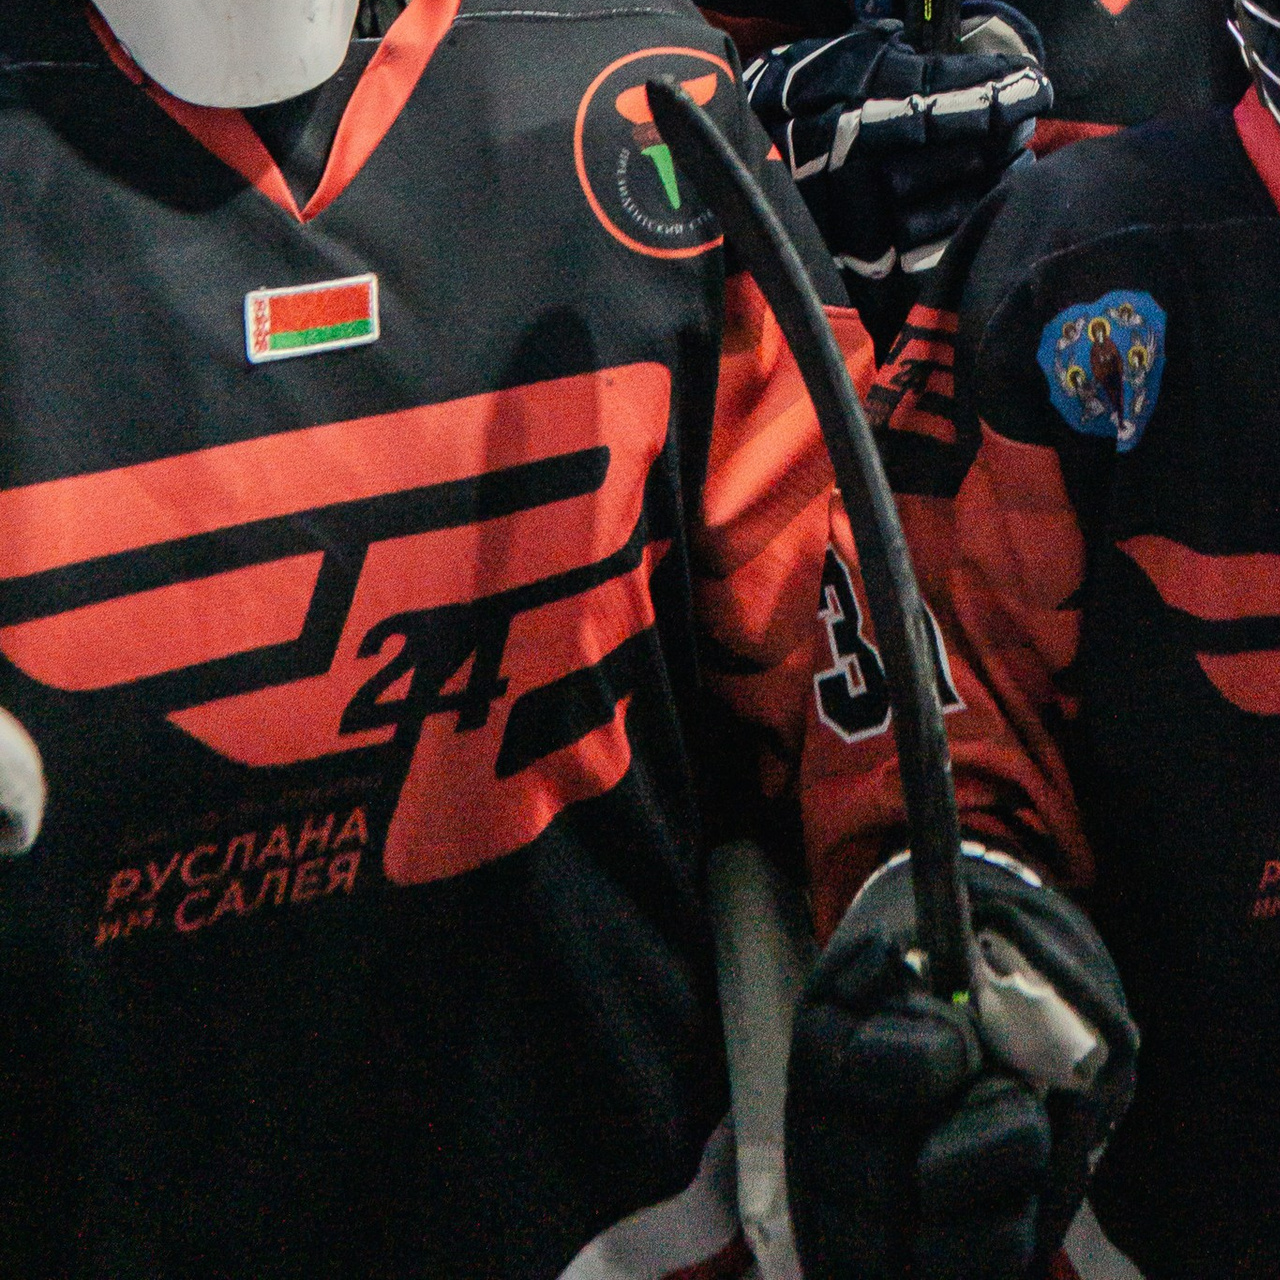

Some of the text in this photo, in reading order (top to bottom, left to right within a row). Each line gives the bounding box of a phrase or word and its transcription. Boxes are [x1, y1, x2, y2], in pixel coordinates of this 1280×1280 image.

[338, 606, 512, 734] 24
[103, 806, 369, 913] РУСЛАНА
[174, 851, 362, 933] САЛЕЯ
